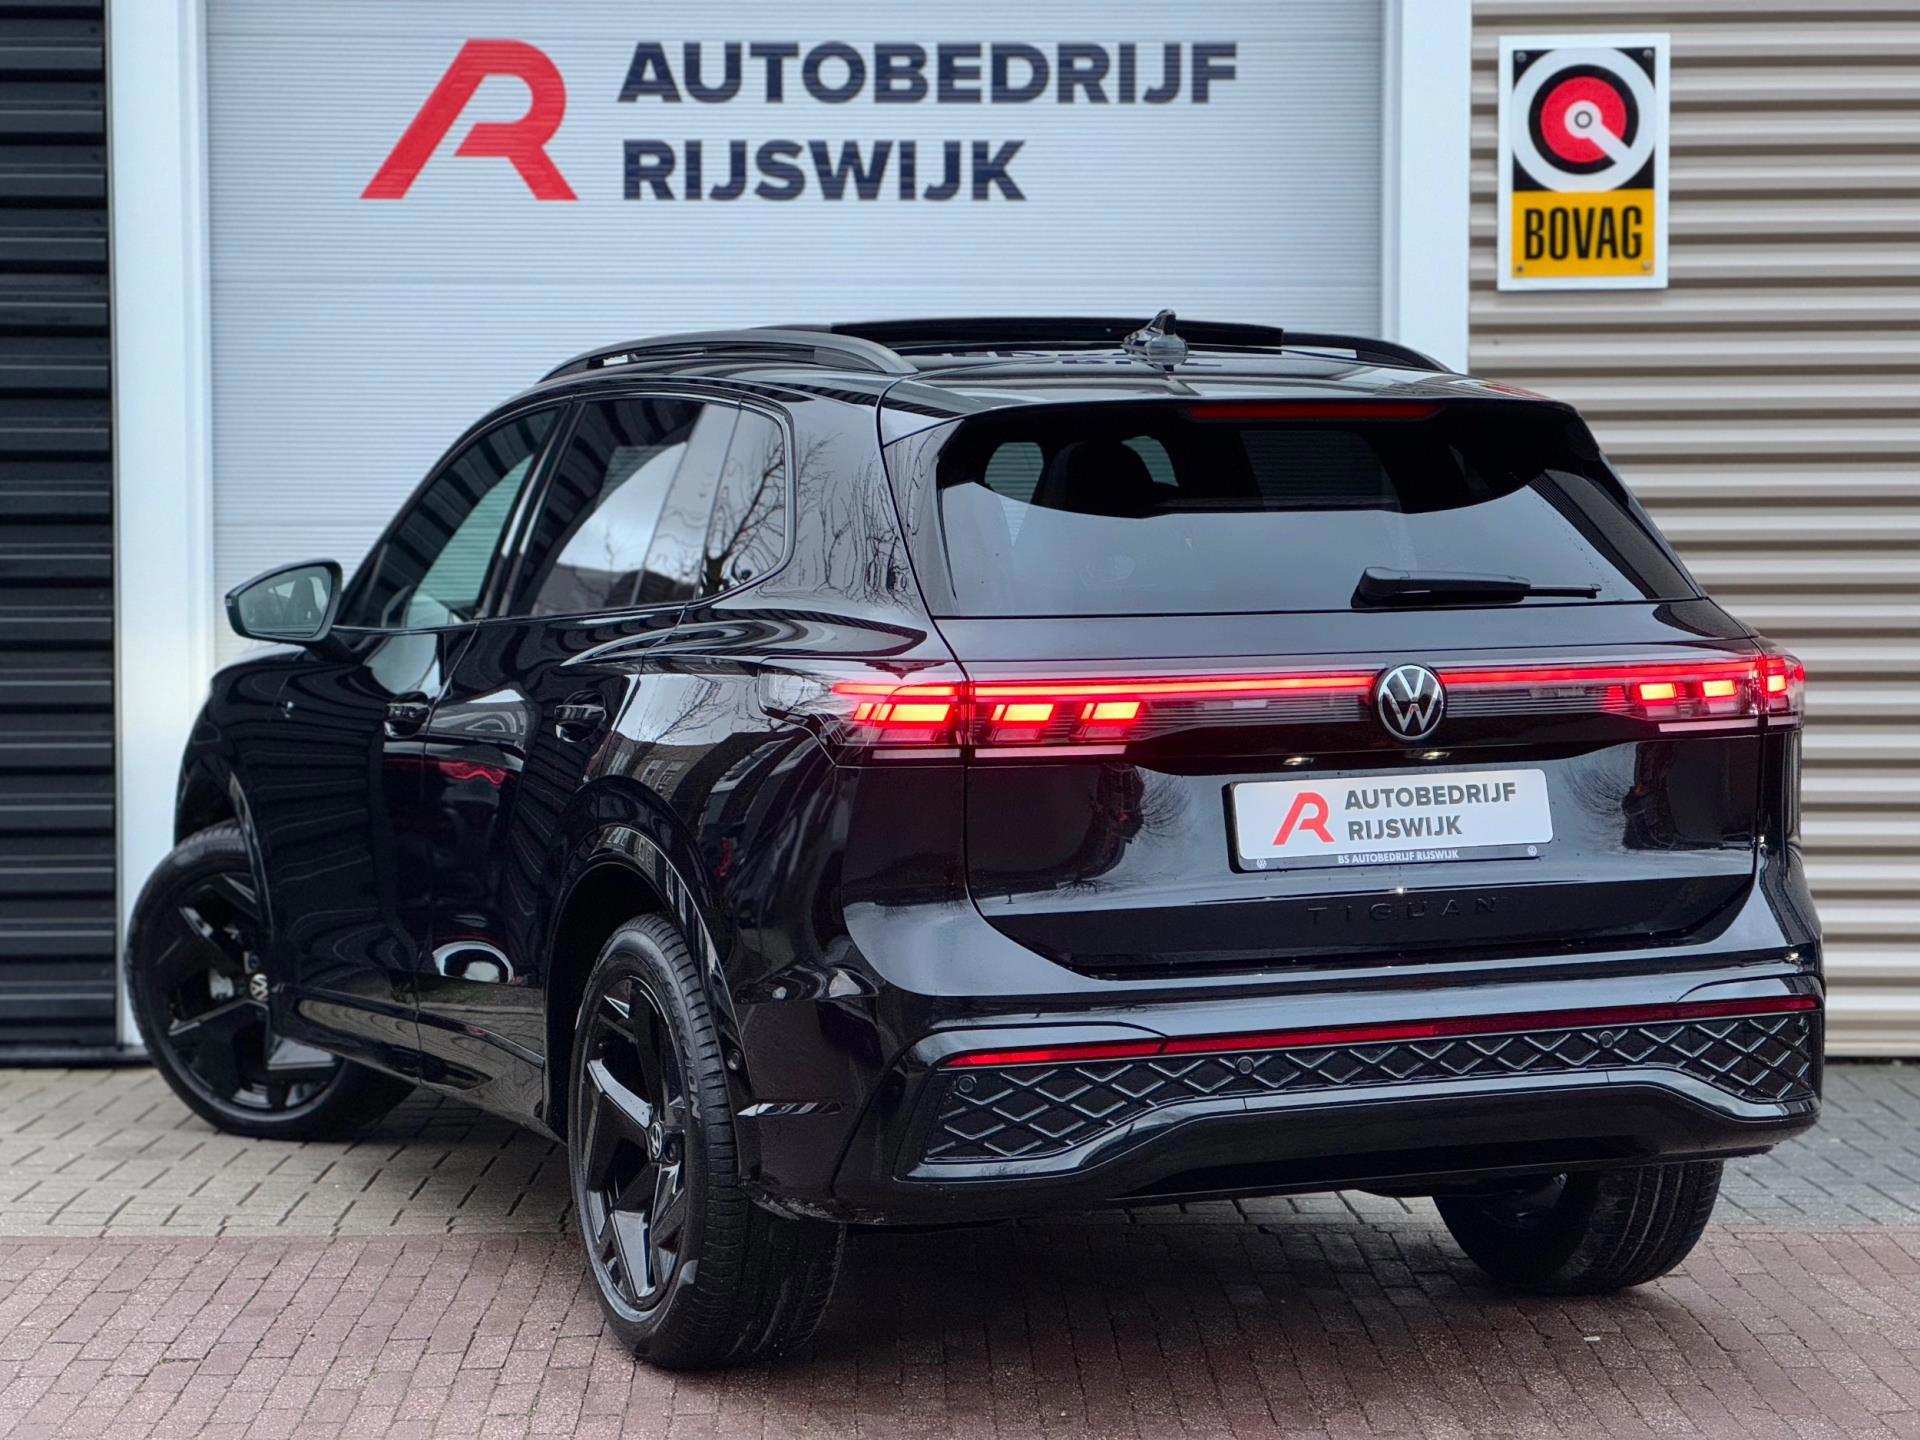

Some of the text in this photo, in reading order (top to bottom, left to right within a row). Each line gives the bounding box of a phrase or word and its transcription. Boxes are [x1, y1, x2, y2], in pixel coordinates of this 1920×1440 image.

[617, 42, 1239, 104] AUTOBEDRIJF
[622, 140, 1028, 201] RIJSWIJK
[1524, 205, 1643, 260] BOVAG
[1344, 782, 1516, 810] AUTOBEDRIJF
[1348, 815, 1463, 841] RIJSWIJK
[1338, 849, 1459, 864] BS AUTOBEDRIJF RIJSWIJK
[1307, 897, 1497, 924] TIGUAN
